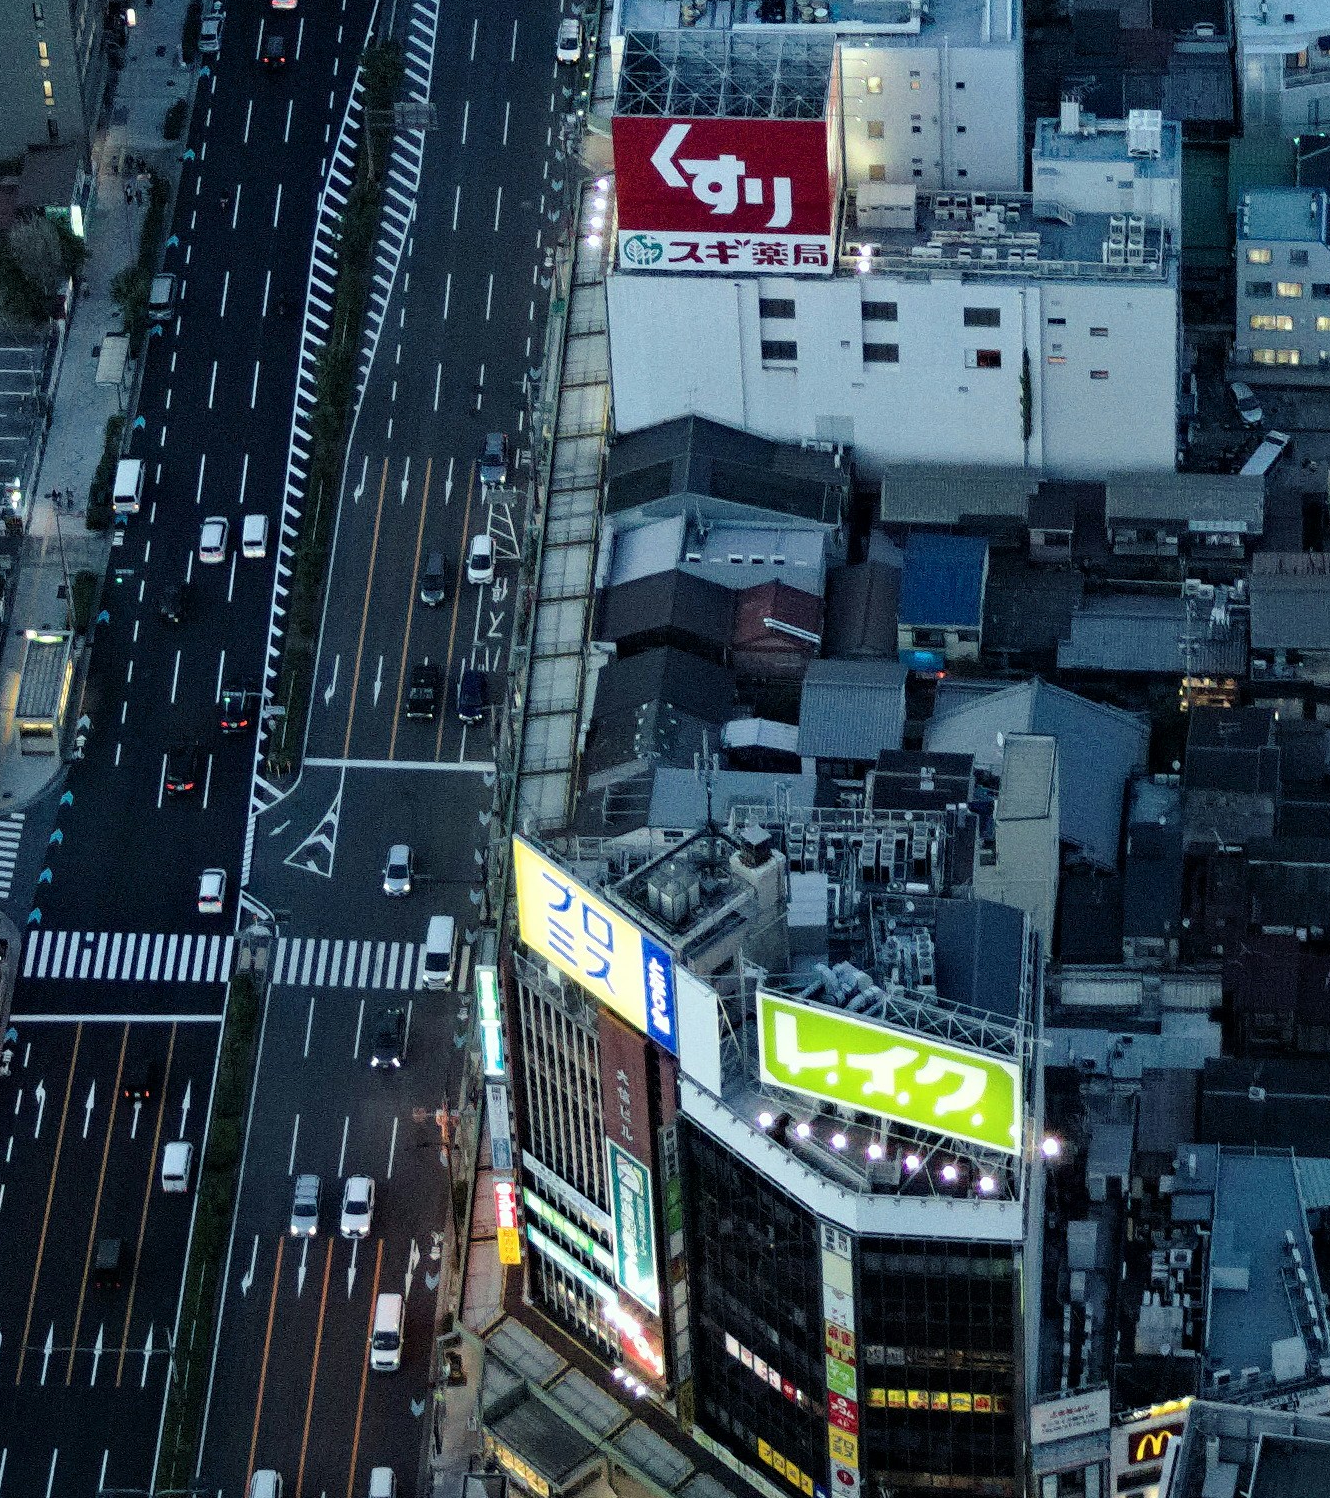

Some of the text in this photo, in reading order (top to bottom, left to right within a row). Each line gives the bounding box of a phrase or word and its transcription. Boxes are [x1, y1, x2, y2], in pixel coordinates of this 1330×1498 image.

[650, 123, 792, 228] くすり
[668, 239, 829, 266] スギ薬局
[775, 1011, 988, 1116] レイク
